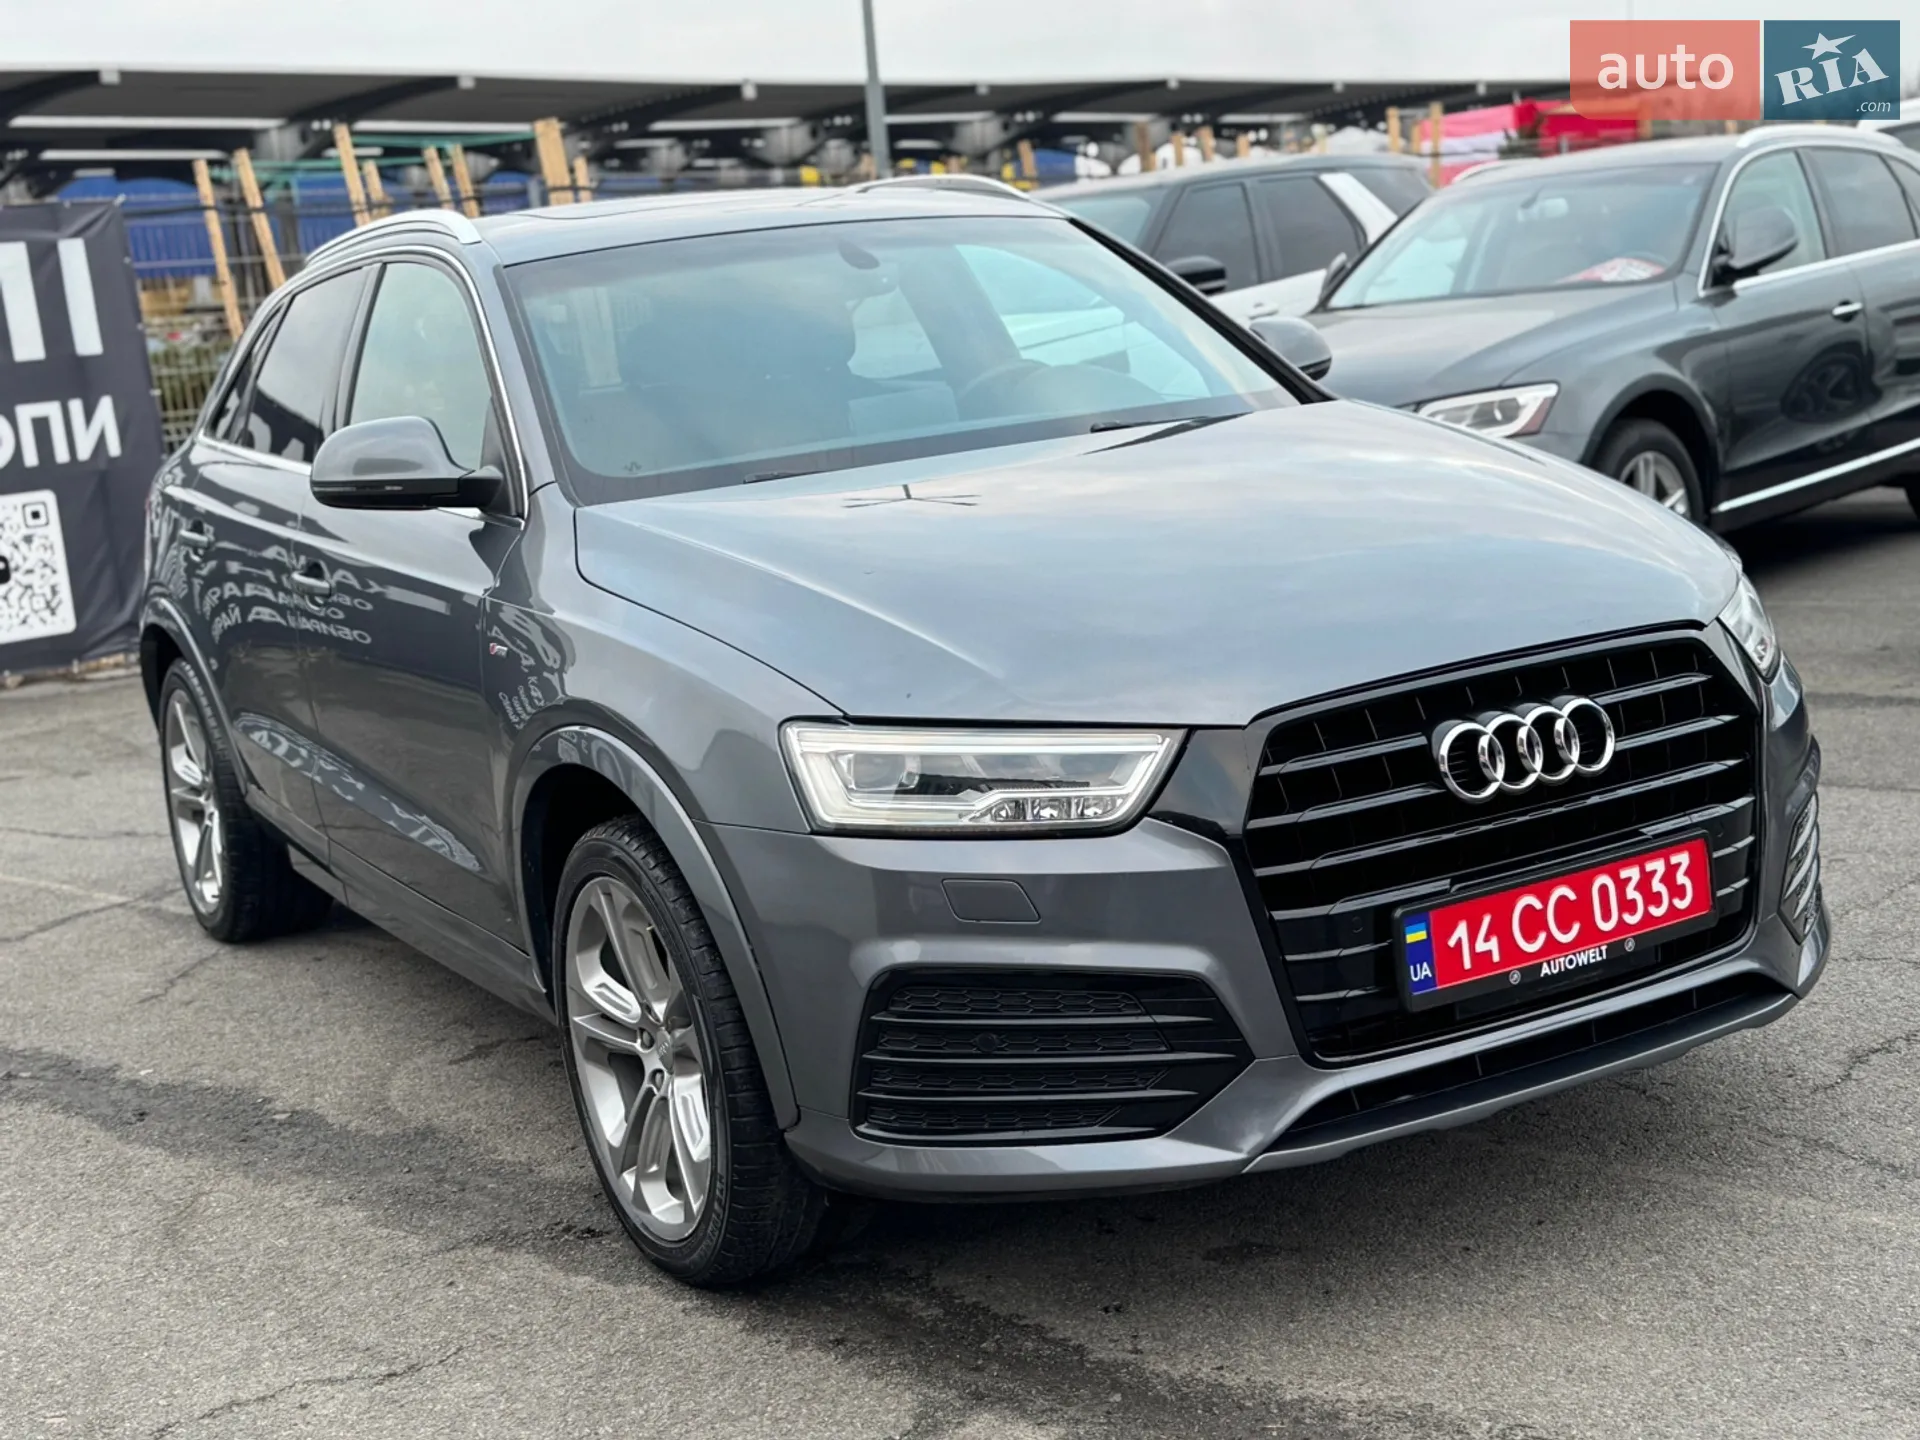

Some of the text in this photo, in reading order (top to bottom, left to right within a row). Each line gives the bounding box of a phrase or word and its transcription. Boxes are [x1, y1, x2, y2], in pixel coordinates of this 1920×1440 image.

[1446, 850, 1694, 971] 14 CC 0333
[1409, 961, 1432, 982] UA
[1539, 945, 1608, 977] AUTOWELT
